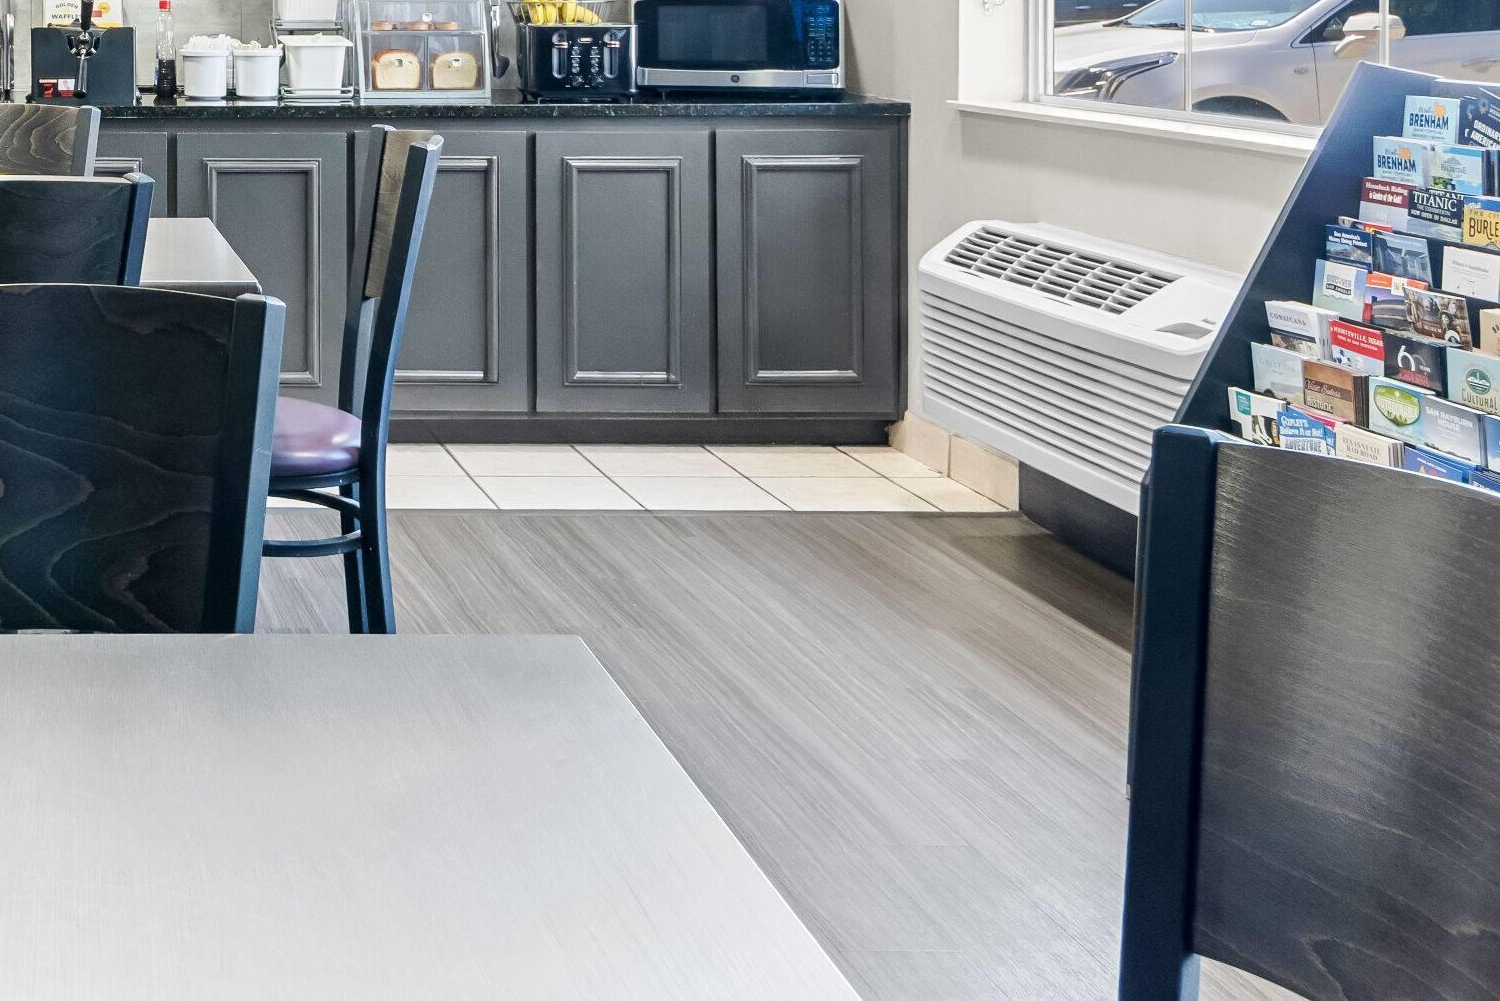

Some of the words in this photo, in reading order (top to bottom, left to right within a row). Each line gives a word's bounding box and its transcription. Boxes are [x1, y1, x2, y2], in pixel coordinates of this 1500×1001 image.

[1409, 113, 1449, 130] BRENHAM
[1377, 155, 1417, 173] BRENHAM
[1412, 190, 1457, 212] TITANIC
[1269, 312, 1307, 327] CORSICANA
[1461, 388, 1498, 410] CULTURAL
[1441, 410, 1474, 430] RAYBURN
